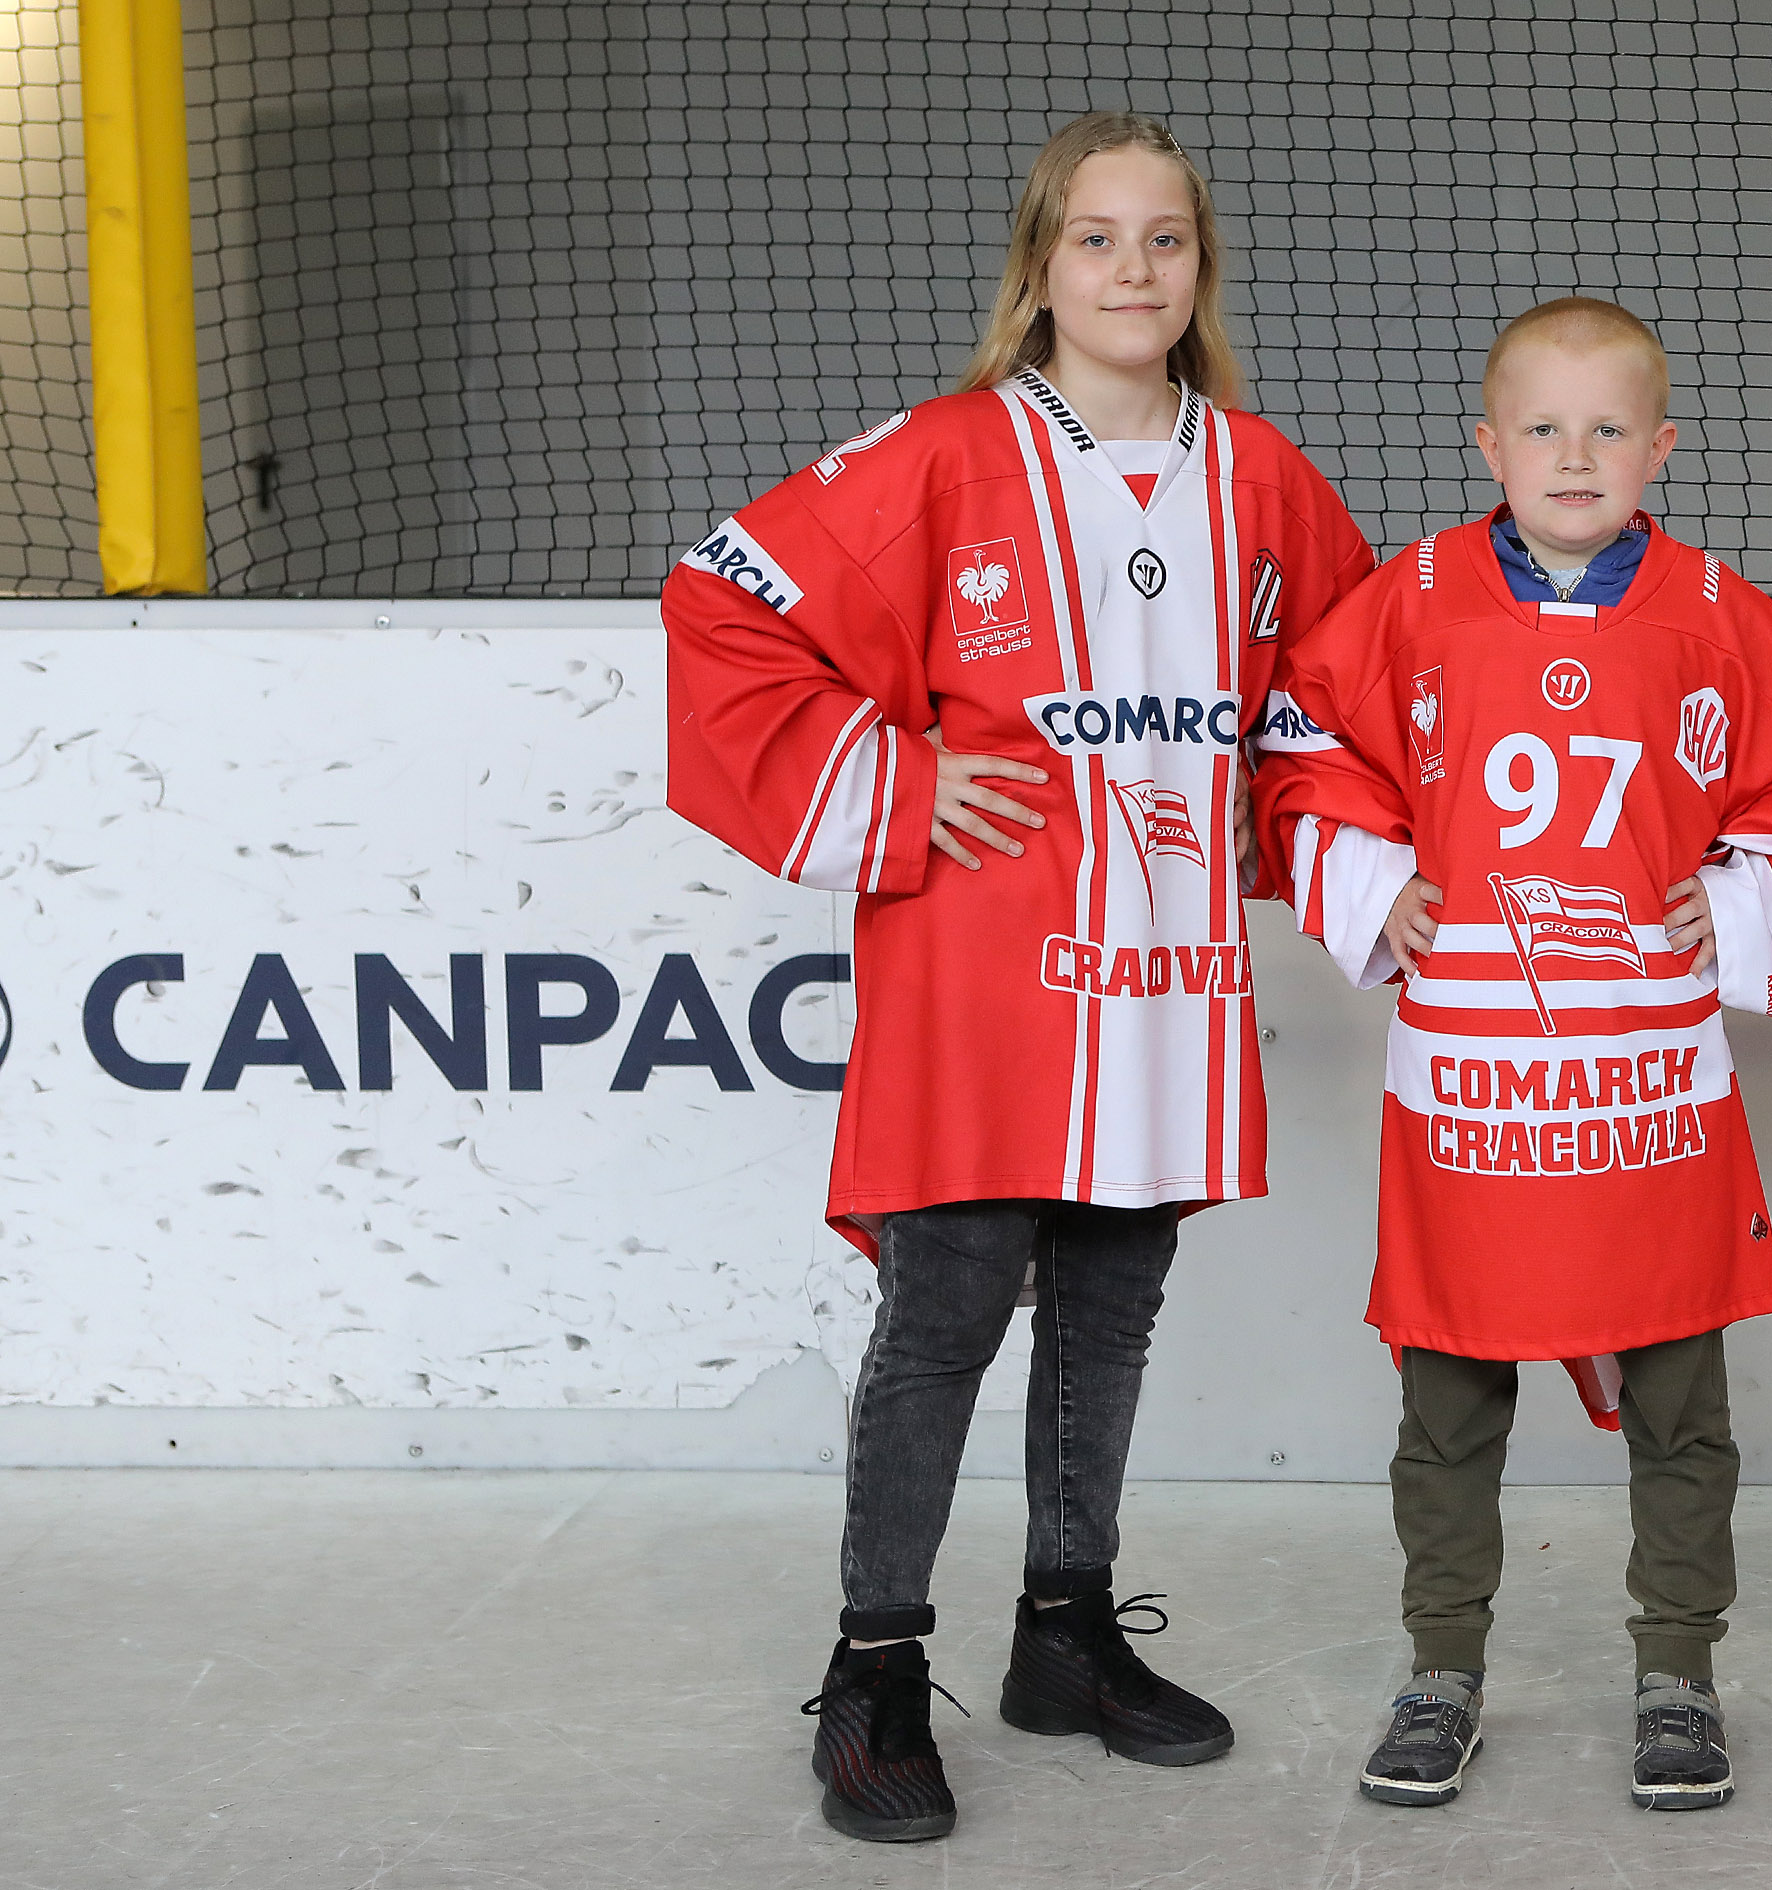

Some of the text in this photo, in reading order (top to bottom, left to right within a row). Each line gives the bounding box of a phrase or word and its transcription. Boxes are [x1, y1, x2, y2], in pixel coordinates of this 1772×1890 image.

[957, 624, 1031, 649] engelbert
[960, 637, 1032, 663] strauss
[1041, 693, 1239, 746] COMARC
[1684, 697, 1726, 778] CHL
[1483, 731, 1644, 849] 97
[1522, 887, 1551, 904] KS
[1540, 922, 1625, 940] CRACOVIA
[82, 953, 851, 1092] CANPAC
[1430, 1046, 1699, 1112] COMARCH
[1427, 1100, 1707, 1178] CRACOVIA
